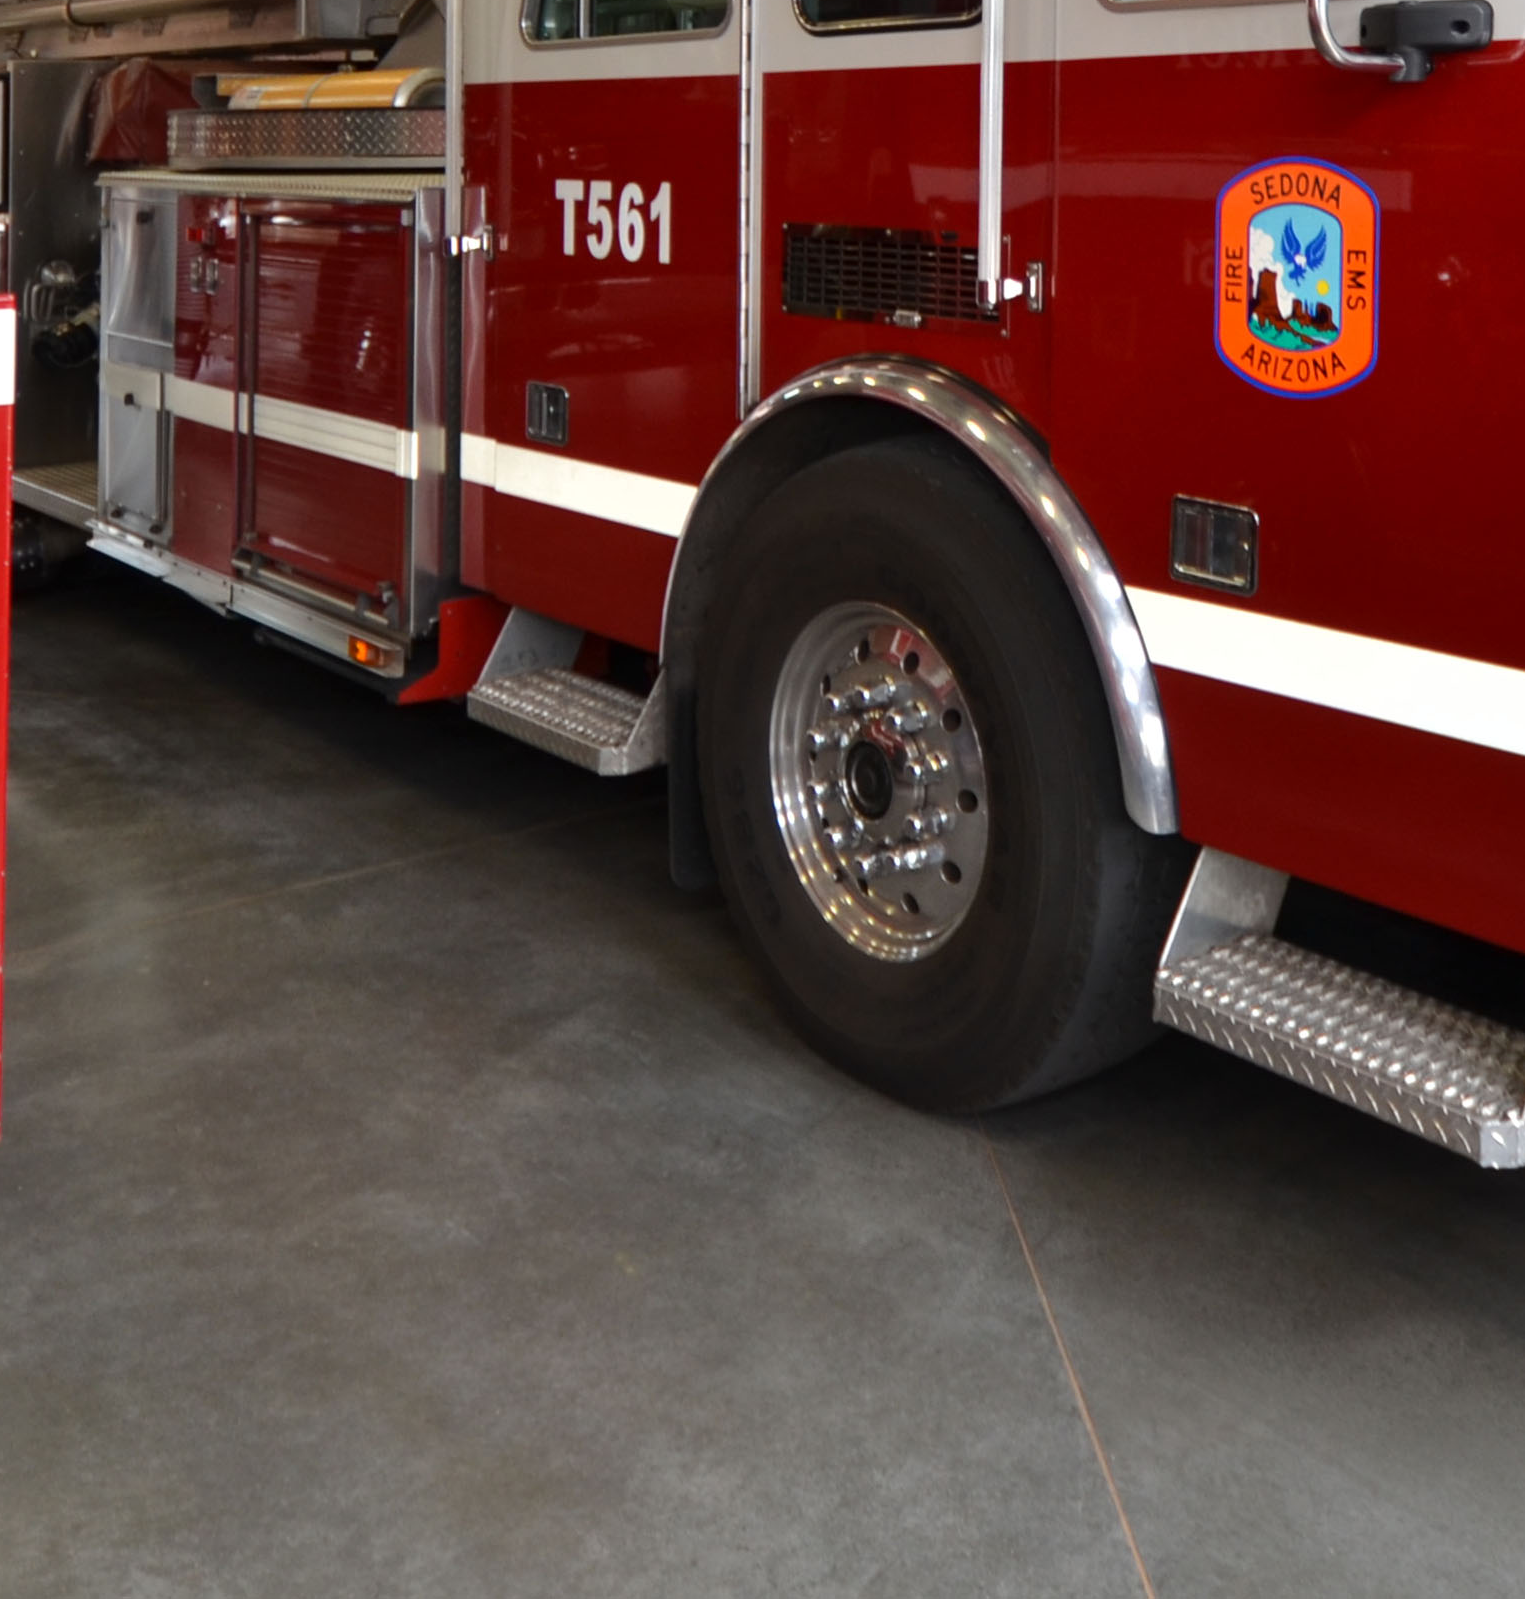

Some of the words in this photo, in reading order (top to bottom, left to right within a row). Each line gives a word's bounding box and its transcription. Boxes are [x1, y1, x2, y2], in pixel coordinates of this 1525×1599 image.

[1250, 172, 1341, 210] SEDONA
[555, 179, 671, 265] T561
[1225, 245, 1244, 303] FIRE
[1346, 249, 1368, 311] EMS
[1240, 343, 1347, 383] ARIZONA
